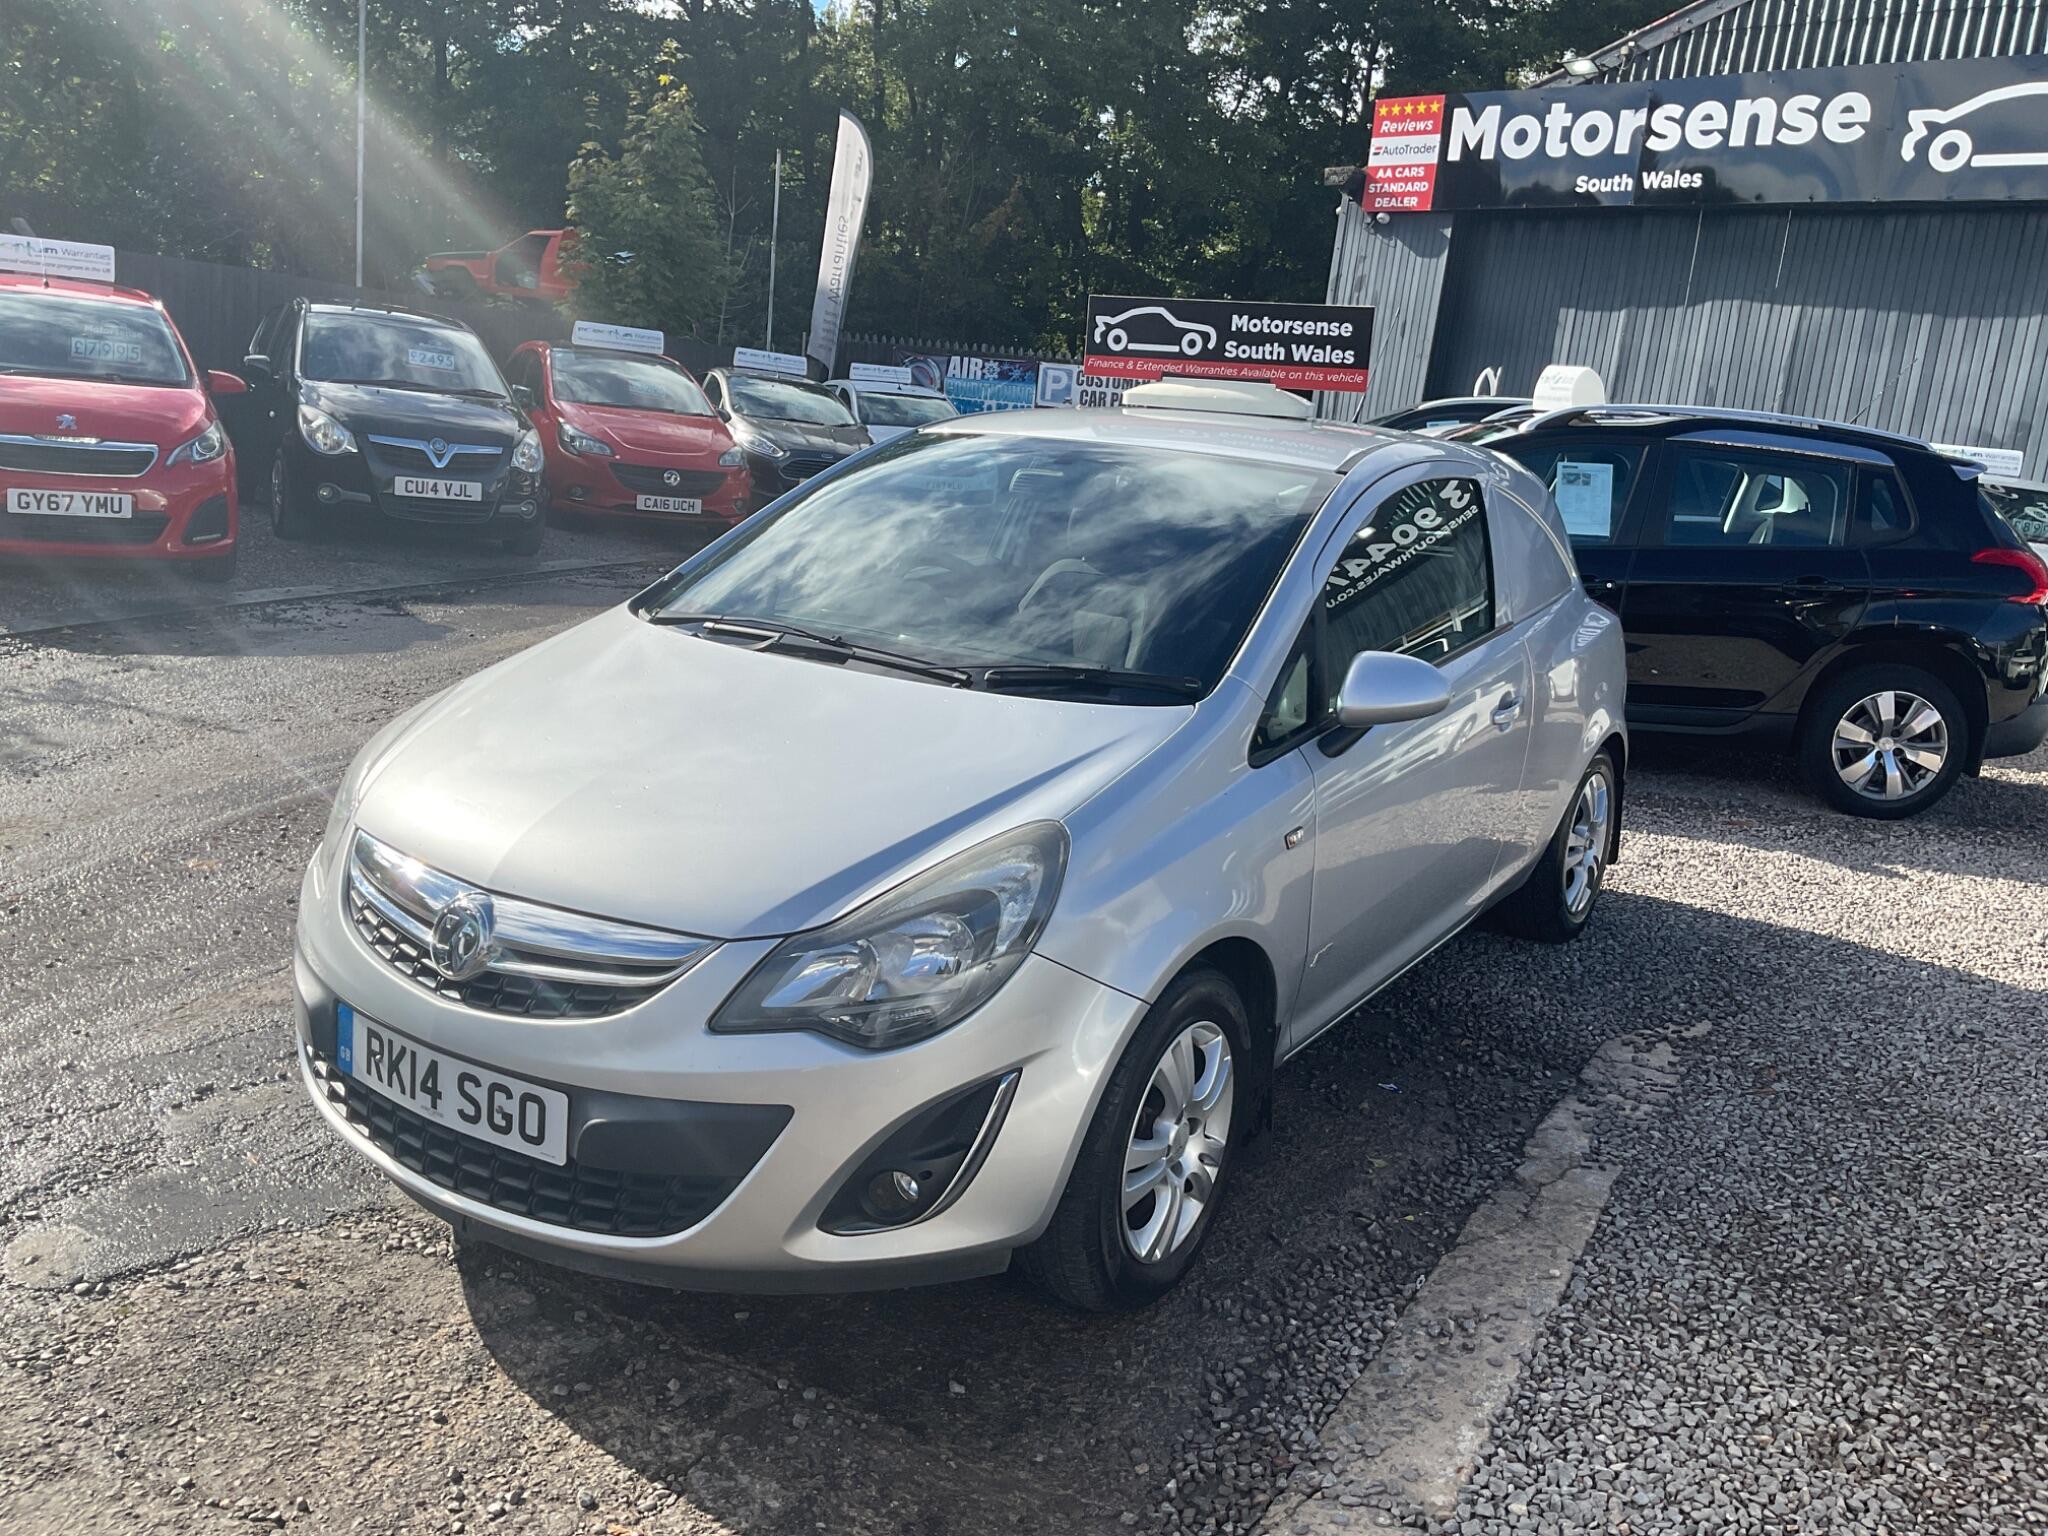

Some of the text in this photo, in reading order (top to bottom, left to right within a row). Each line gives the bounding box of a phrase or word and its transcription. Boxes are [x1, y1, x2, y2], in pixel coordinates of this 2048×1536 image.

[1380, 119, 1434, 133] Reviews
[1447, 91, 1871, 161] Motorsense
[1382, 143, 1437, 156] AutoTrader
[1376, 167, 1425, 179] AA CARS
[1574, 169, 1703, 193] South Wales
[1368, 181, 1429, 193] STANDARD
[1374, 197, 1418, 208] DEALER
[1230, 314, 1353, 337] Motorsense
[74, 340, 140, 361] £7995
[1224, 341, 1355, 365] South Wales
[947, 356, 983, 380] AIR
[1087, 358, 1364, 384] Finance & Extended Warranties Available on this vehicle
[1044, 368, 1069, 401] P
[1080, 389, 1108, 408] CAR
[405, 479, 473, 499] CU14 VJL
[17, 492, 123, 515] GY67 YMU
[644, 497, 695, 512] CA16 UCH
[366, 1027, 547, 1147] RK14 SGO
